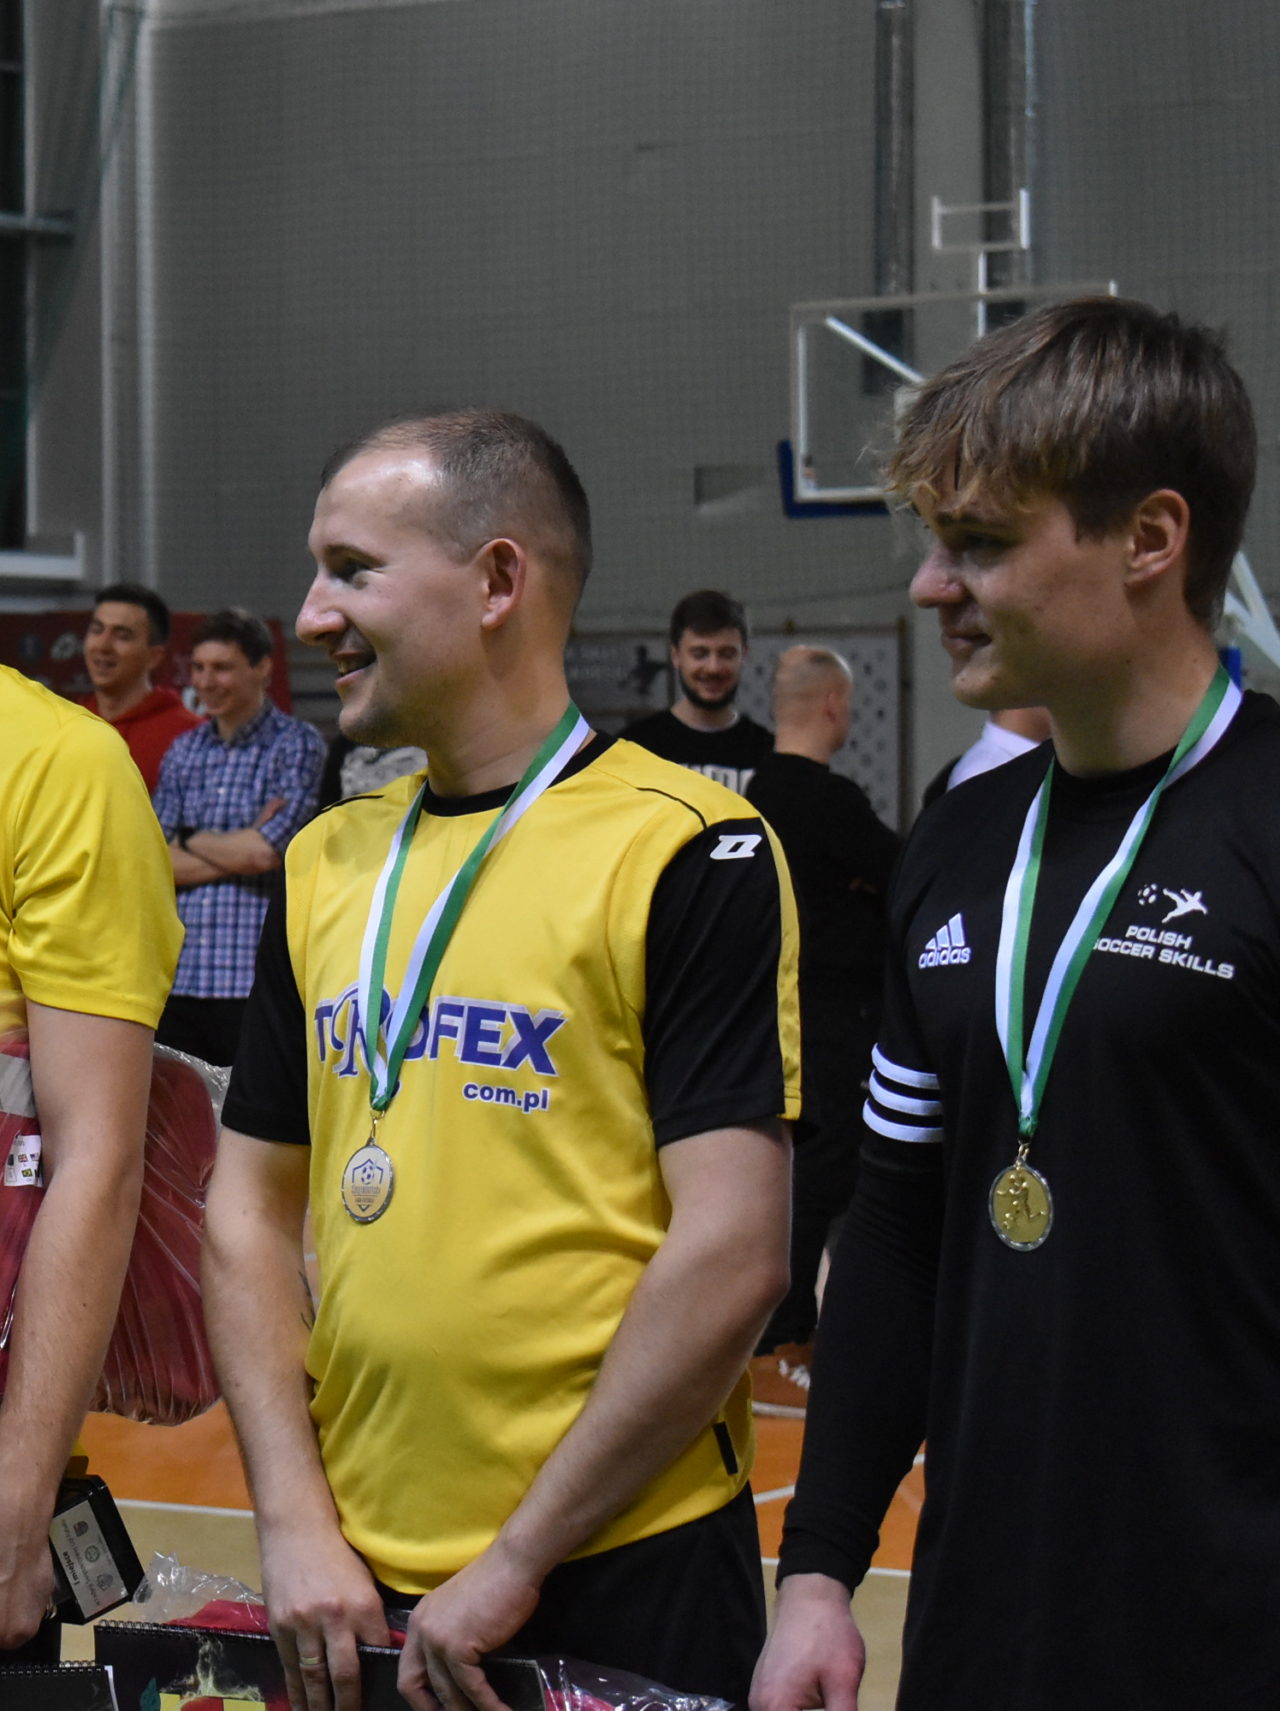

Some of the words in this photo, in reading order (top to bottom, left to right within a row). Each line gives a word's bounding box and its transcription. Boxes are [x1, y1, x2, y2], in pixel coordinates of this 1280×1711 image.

[1125, 925, 1193, 949] POLISH
[918, 946, 971, 970] adidas
[1158, 948, 1235, 980] SKILLS
[463, 1082, 550, 1115] com.pl
